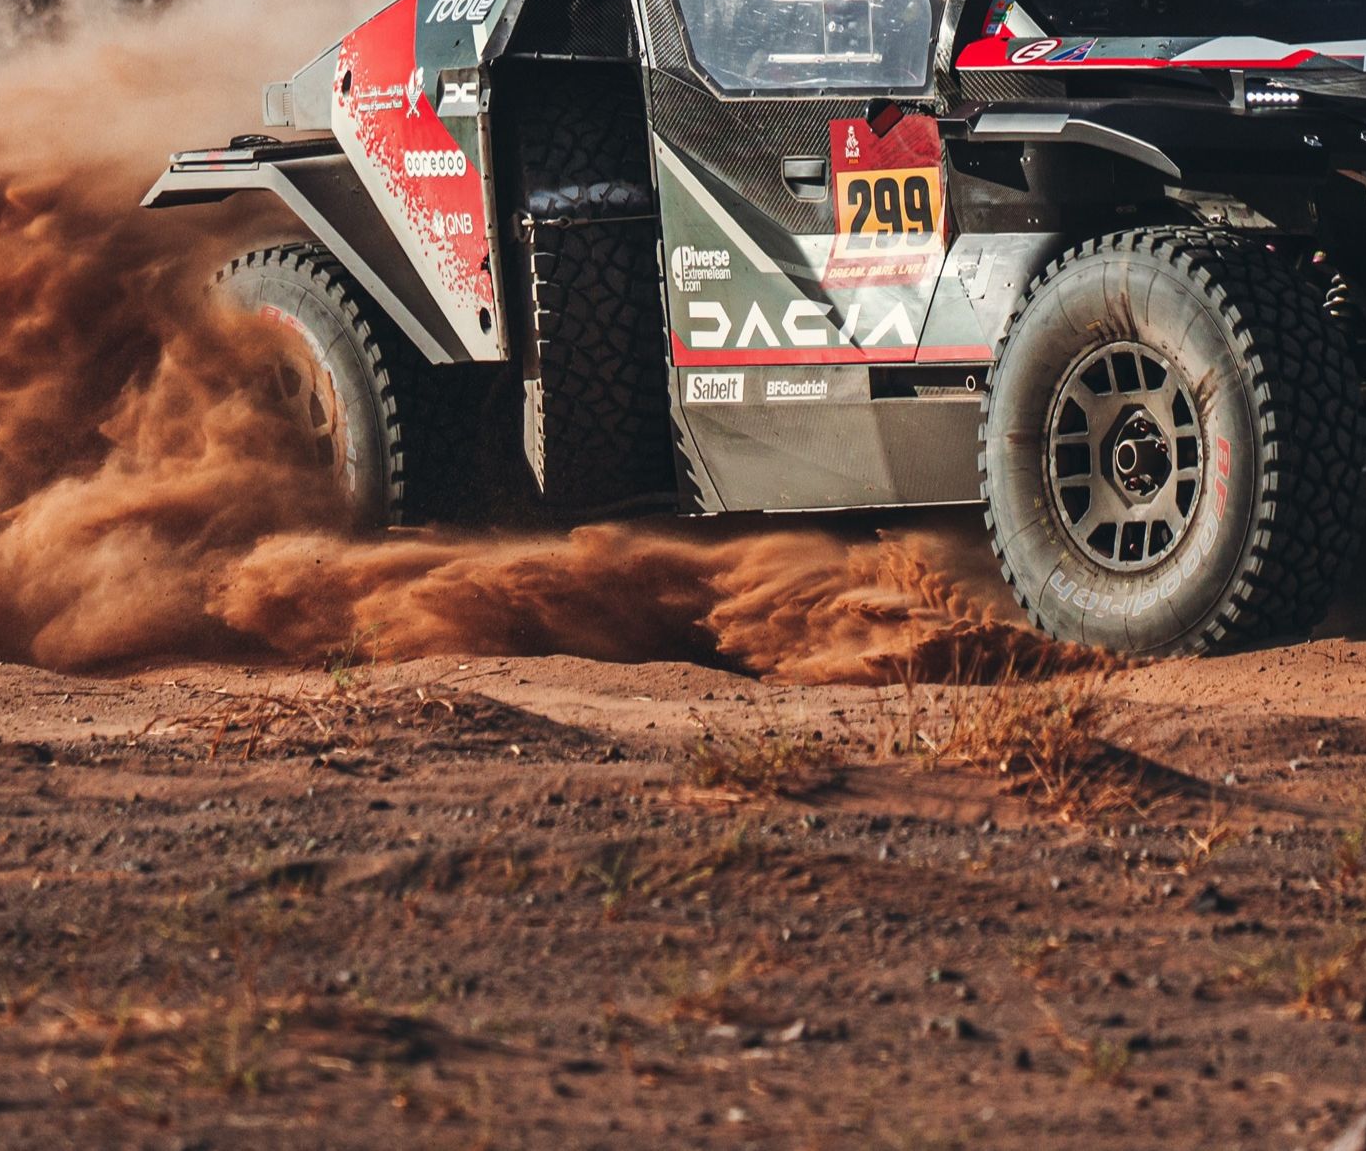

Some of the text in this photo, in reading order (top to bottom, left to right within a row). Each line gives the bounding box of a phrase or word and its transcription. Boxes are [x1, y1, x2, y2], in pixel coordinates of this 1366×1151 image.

[405, 152, 466, 174] ooredoo
[845, 176, 935, 250] 299
[446, 213, 473, 236] QNB
[681, 245, 731, 266] Diverse
[683, 266, 732, 280] ExtremeTeam
[828, 266, 865, 279] DREAM.
[684, 280, 702, 292] .com
[688, 300, 919, 348] DACIA
[692, 375, 738, 400] Sabelt
[766, 380, 828, 395] BFGoodrich
[1049, 435, 1232, 618] BFGoodrich
